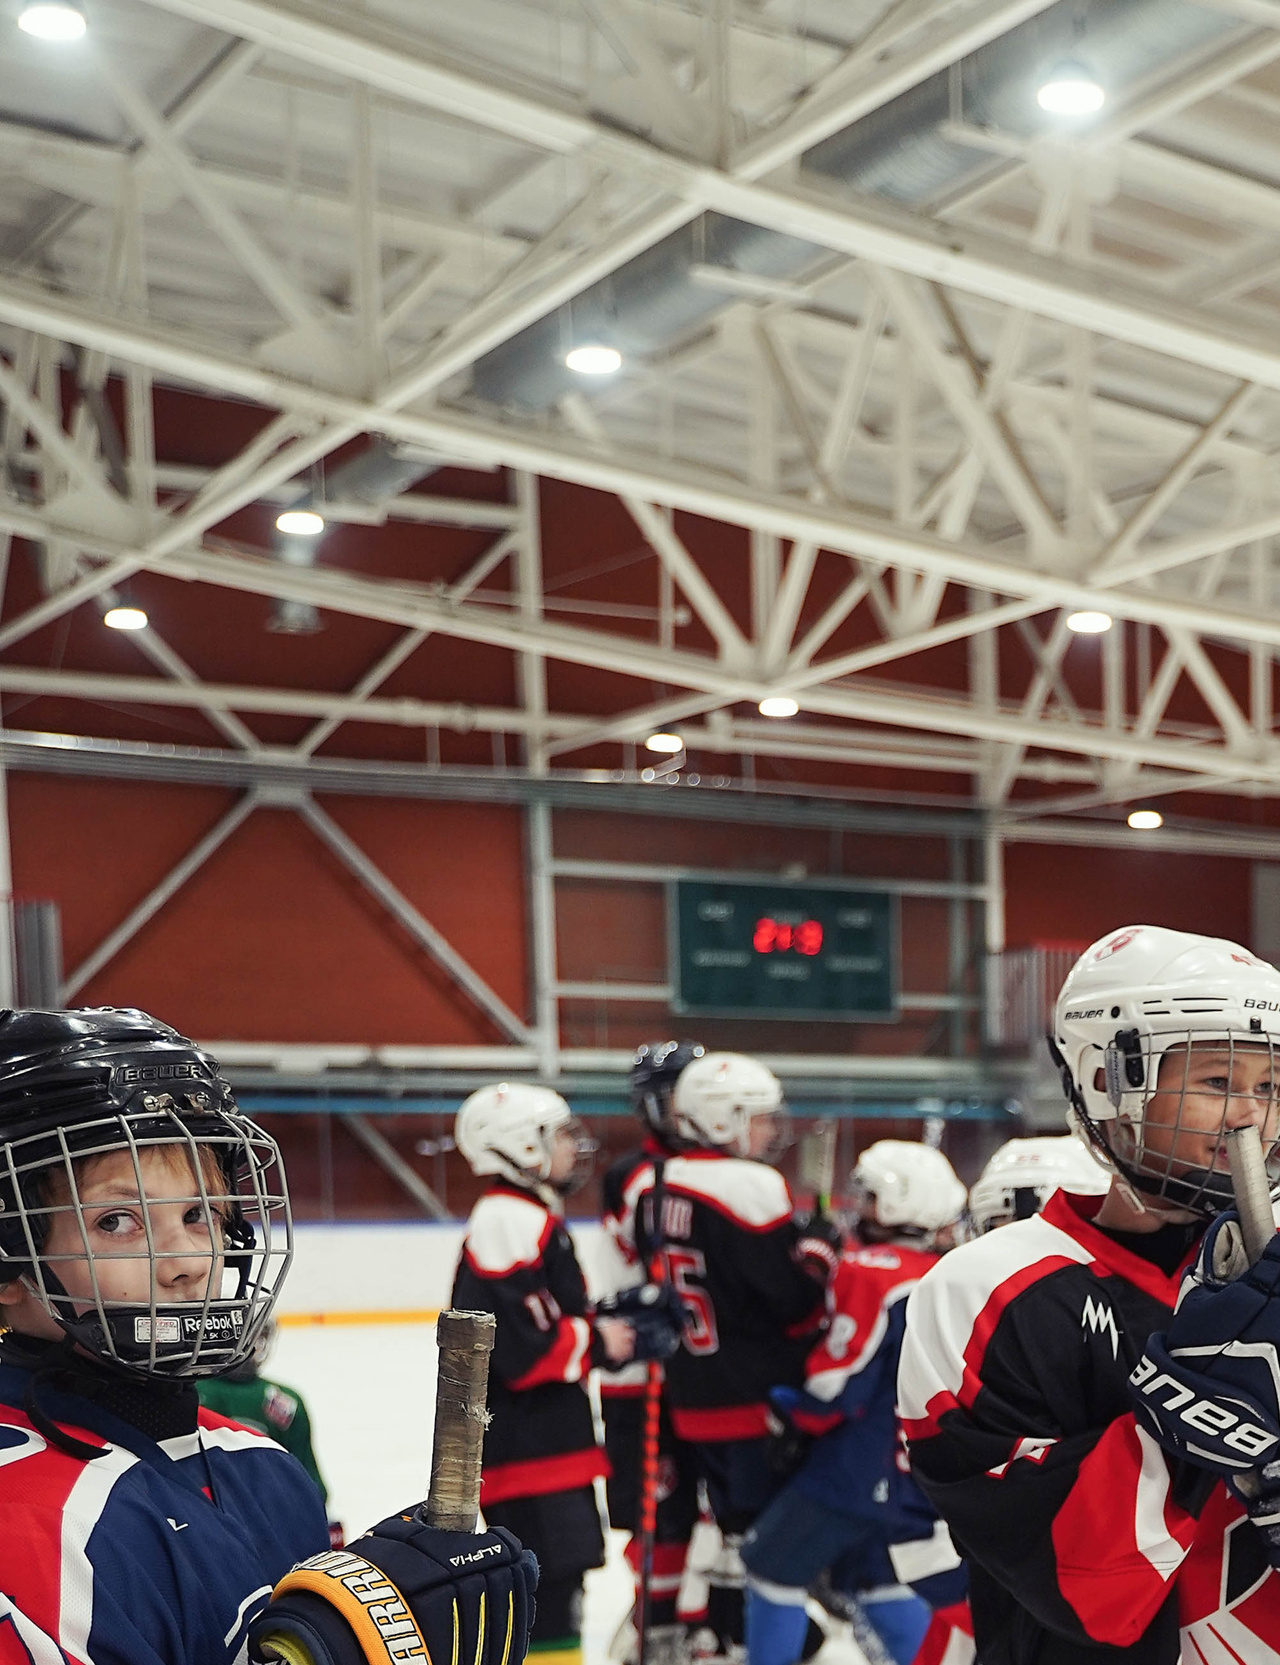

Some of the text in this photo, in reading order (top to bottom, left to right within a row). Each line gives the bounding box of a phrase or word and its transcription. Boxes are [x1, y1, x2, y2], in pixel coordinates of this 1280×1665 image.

[1064, 1008, 1104, 1021] BAUER
[123, 1064, 204, 1083] BAUER
[184, 1315, 233, 1333] Reebok
[449, 1544, 502, 1568] ALPHA
